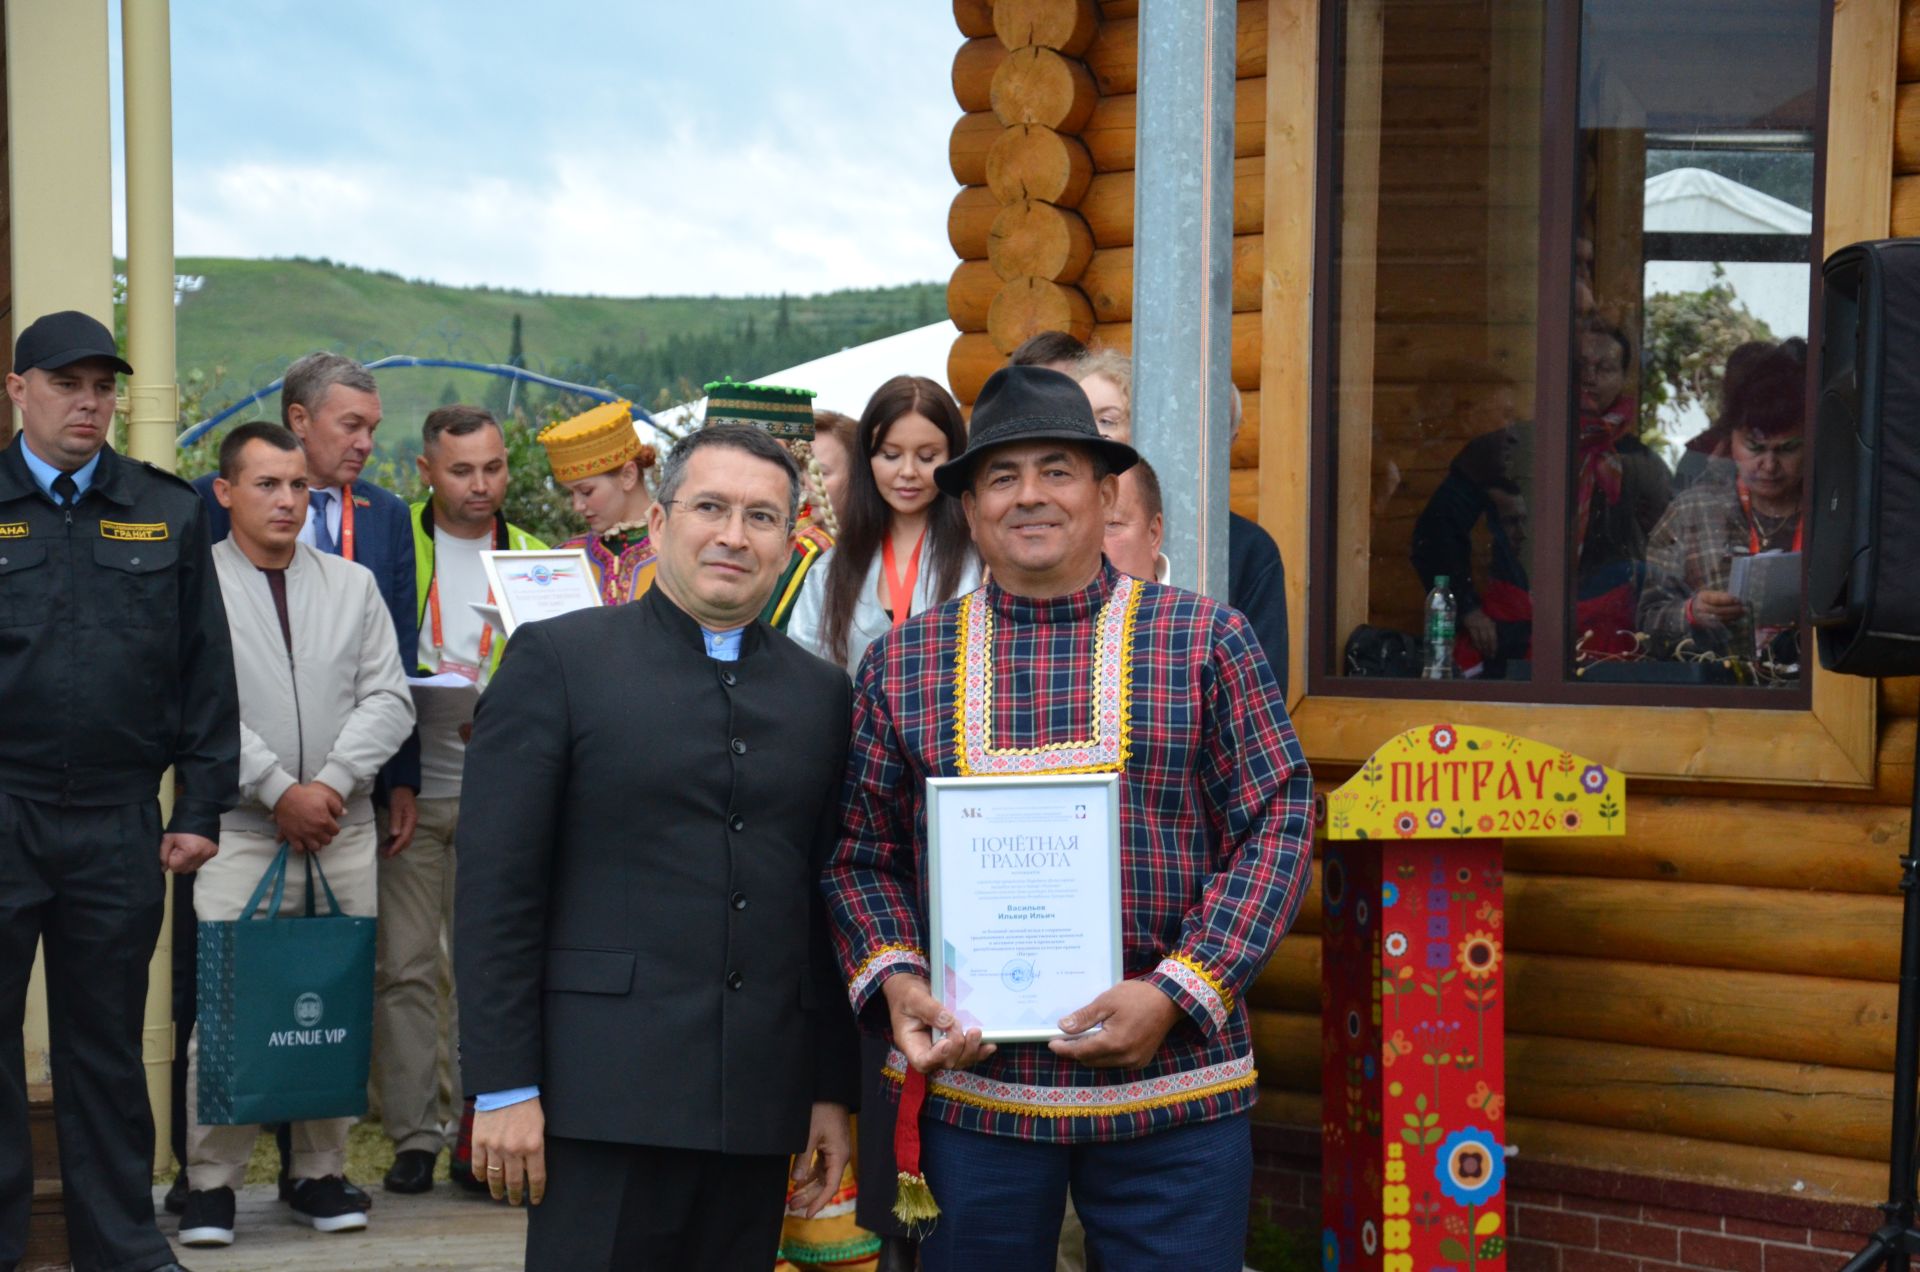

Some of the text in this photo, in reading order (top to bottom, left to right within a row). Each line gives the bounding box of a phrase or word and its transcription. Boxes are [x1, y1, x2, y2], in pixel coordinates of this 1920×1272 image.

[114, 529, 152, 538] ГРАНИТ
[1391, 759, 1554, 802] ПИТРАУ
[1498, 809, 1557, 832] 2026
[972, 835, 1078, 852] ПОЧЁТНАЯ
[981, 853, 1070, 868] ГРАМОТА
[1007, 904, 1046, 912] Васильев
[268, 1028, 347, 1047] AVENUE VIP
